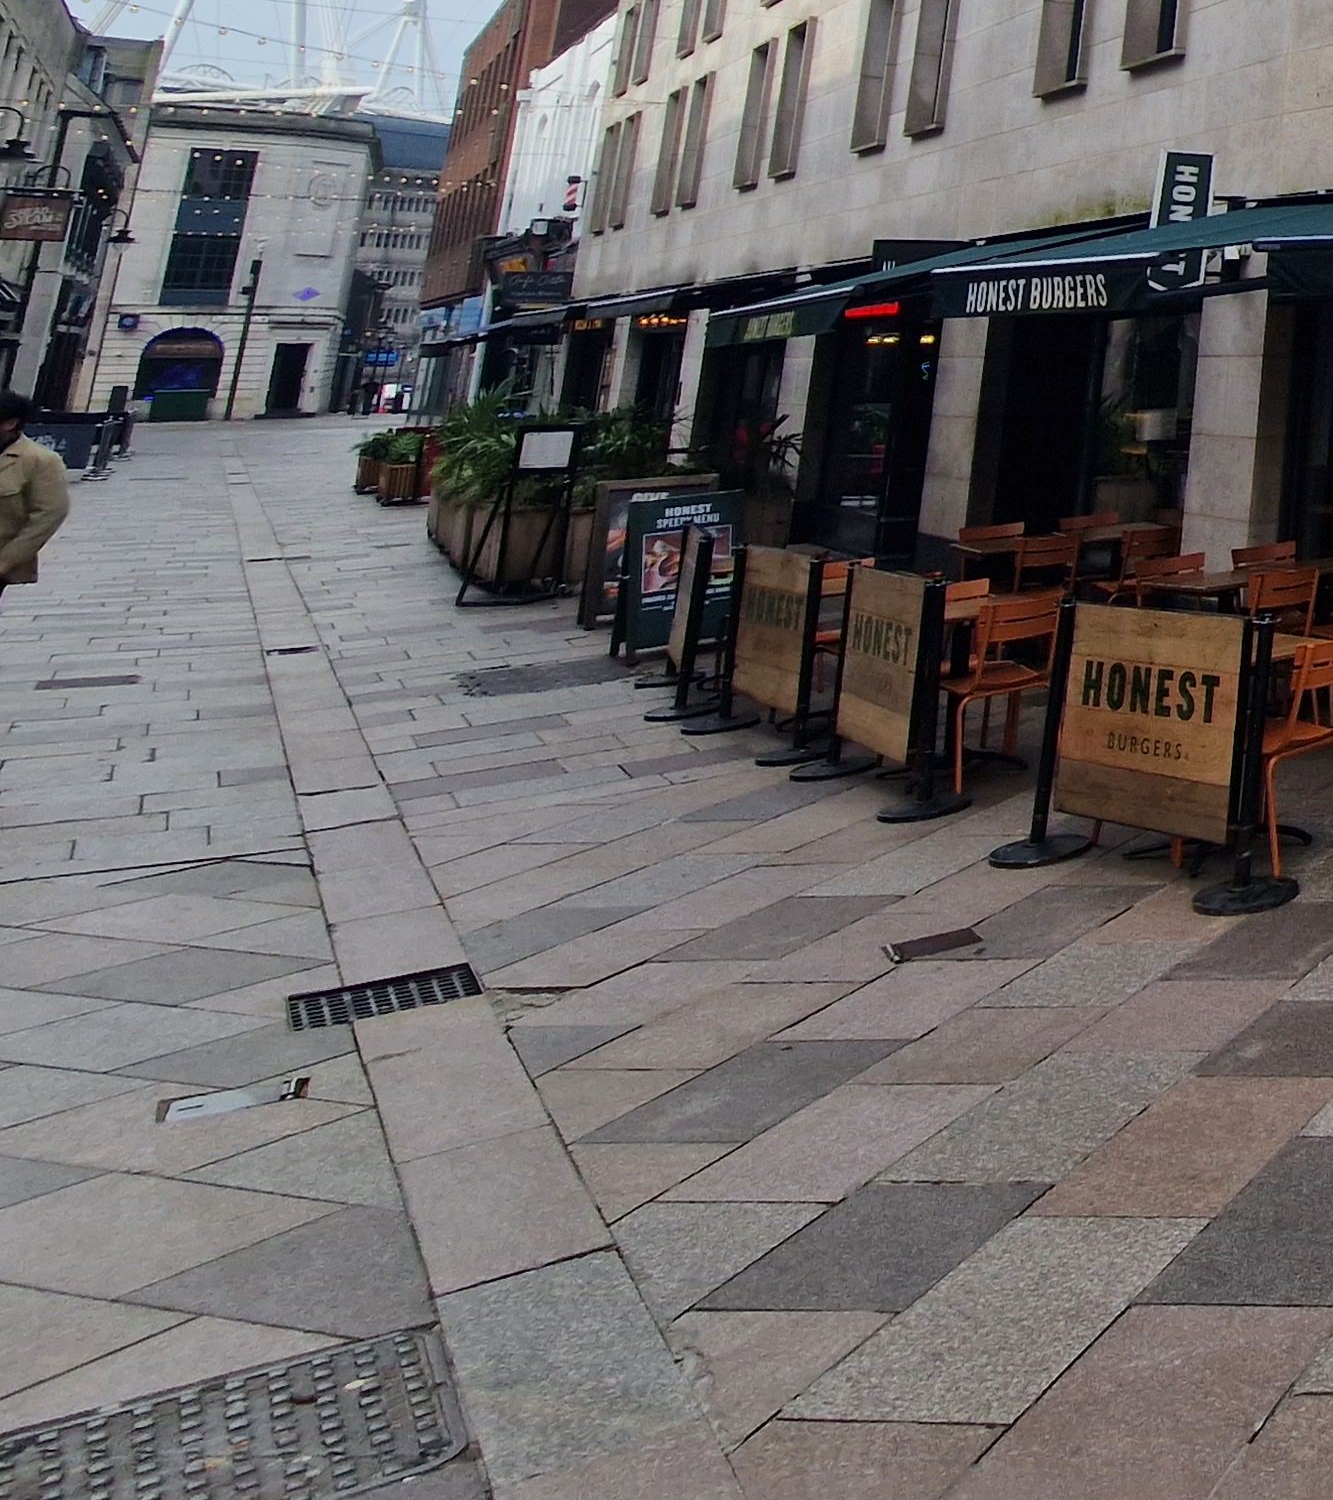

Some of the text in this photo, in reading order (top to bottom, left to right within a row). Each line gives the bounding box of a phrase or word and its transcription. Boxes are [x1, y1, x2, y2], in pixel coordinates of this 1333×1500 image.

[966, 273, 1108, 314] HONEST BURGERS
[664, 503, 712, 518] HONEST
[853, 612, 912, 666] HONEST
[1082, 660, 1221, 724] HONEST
[1107, 732, 1182, 760] BURGERS
